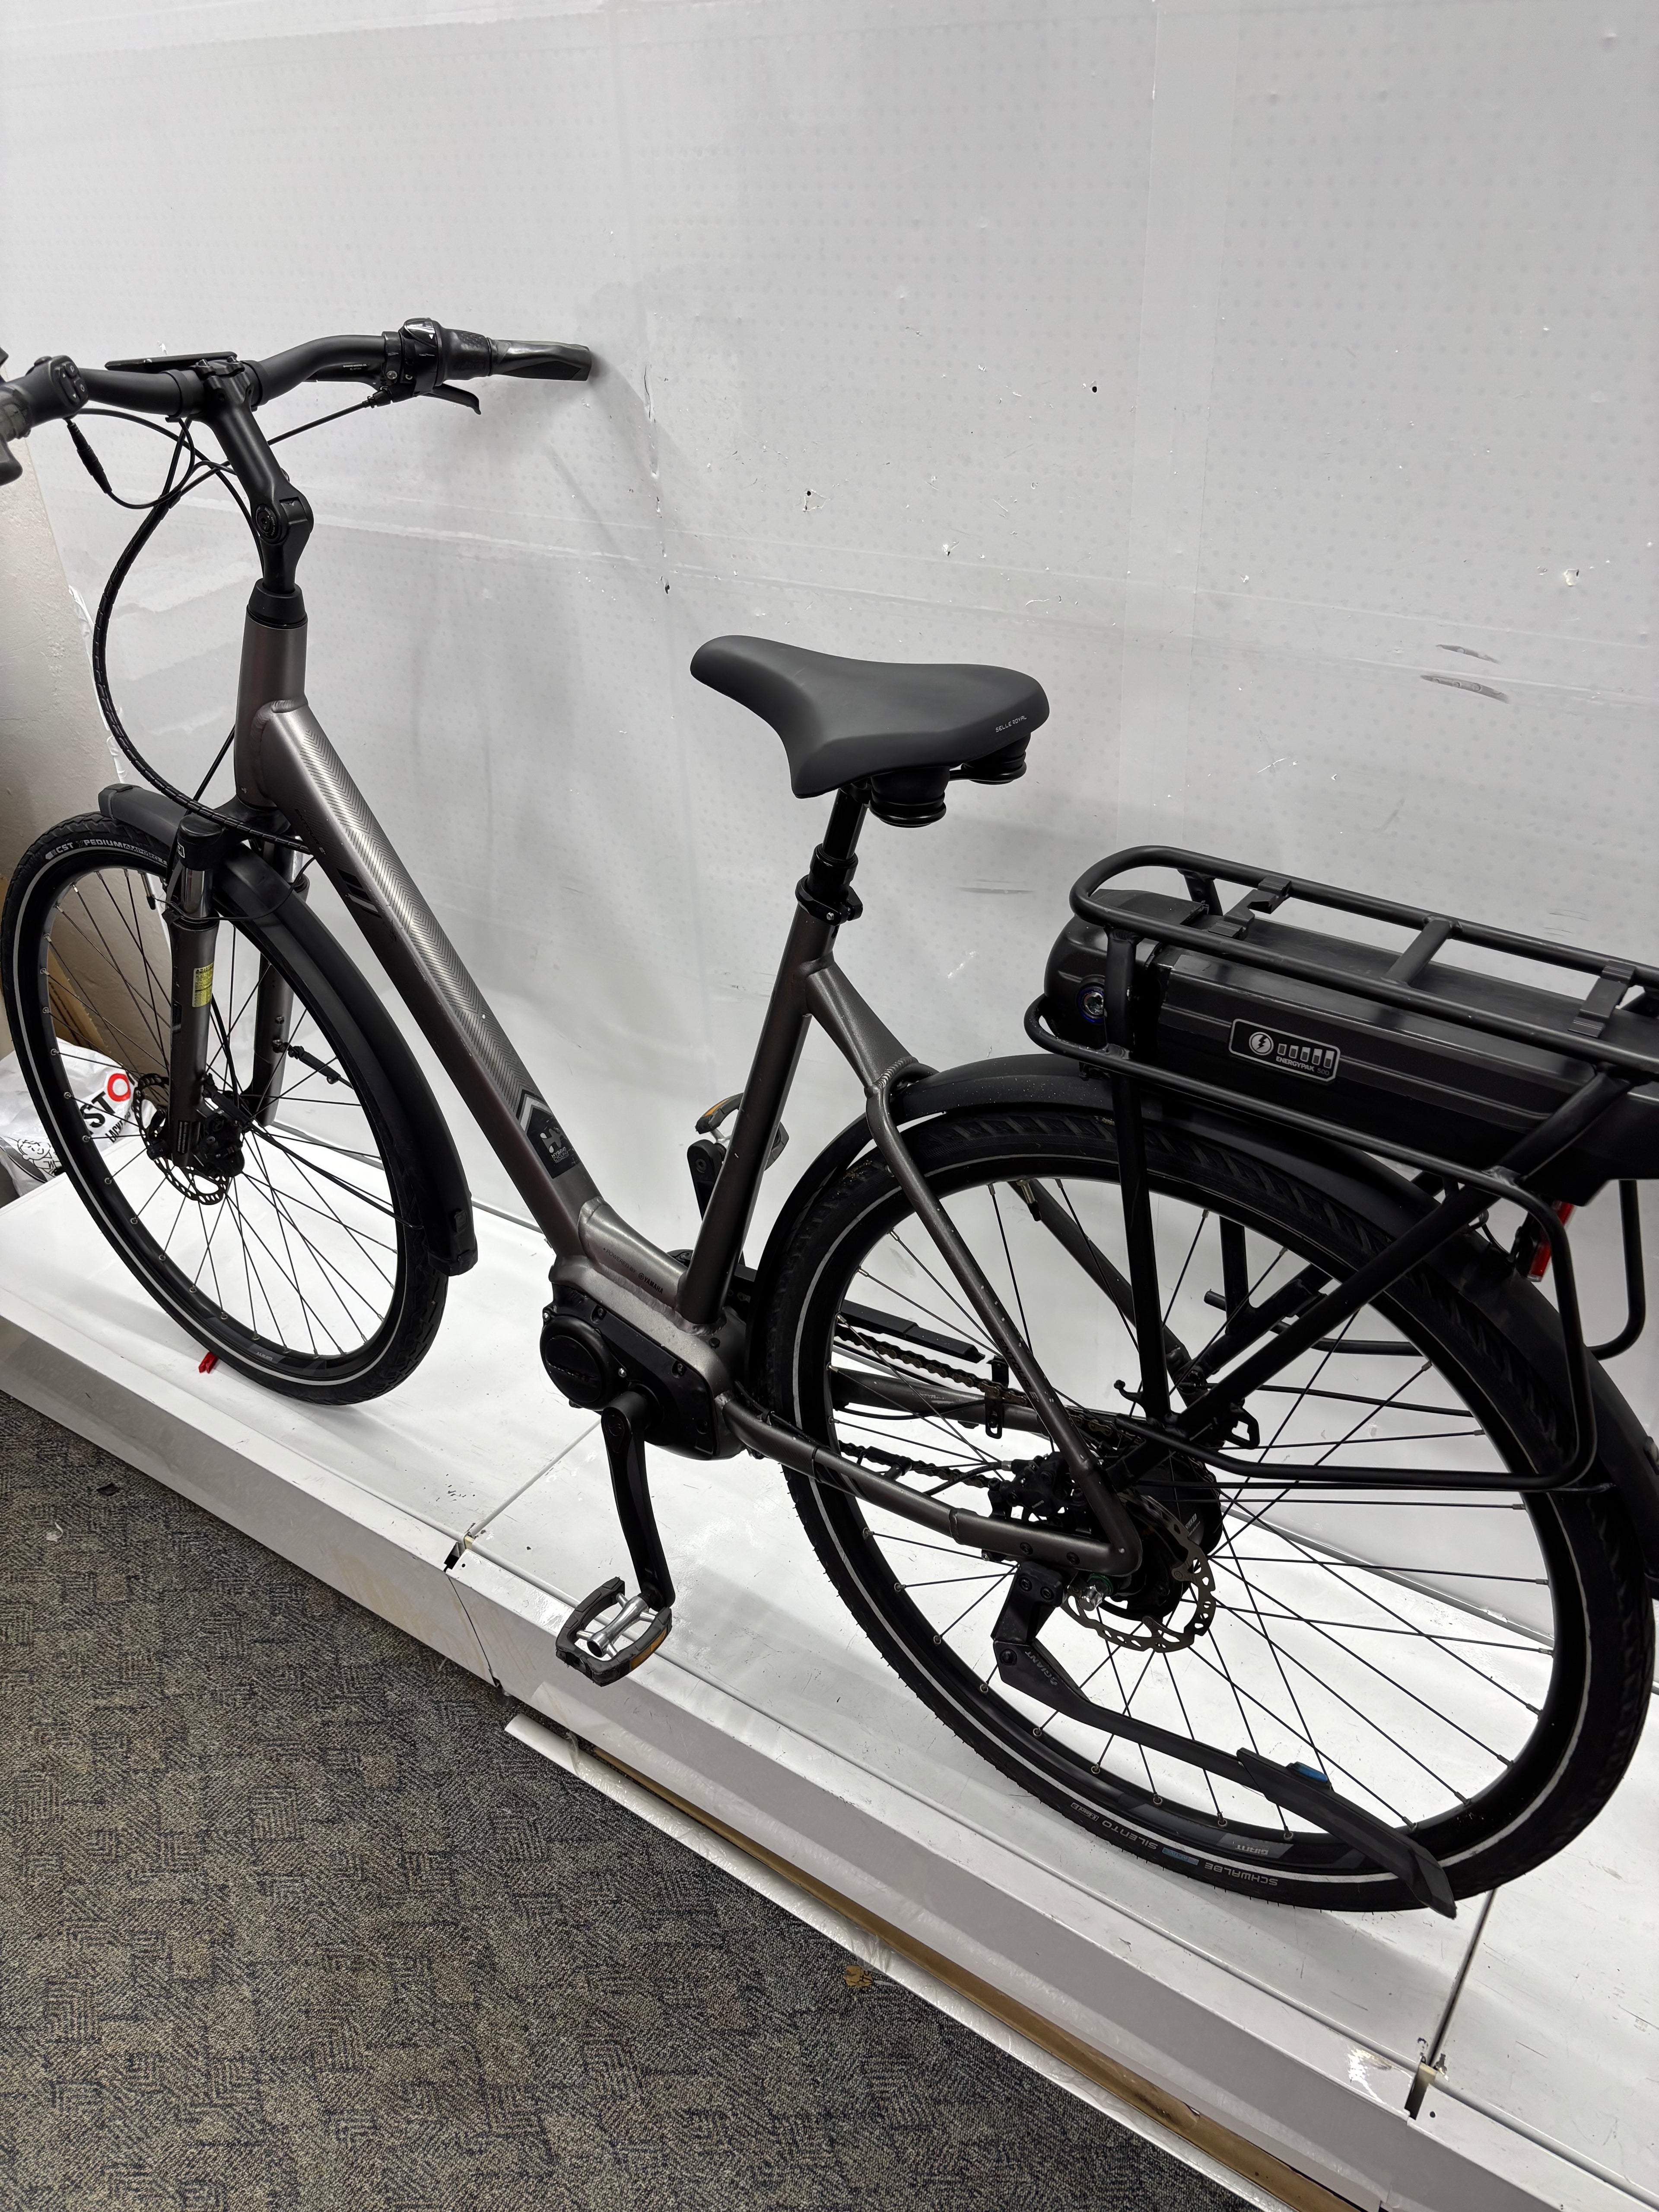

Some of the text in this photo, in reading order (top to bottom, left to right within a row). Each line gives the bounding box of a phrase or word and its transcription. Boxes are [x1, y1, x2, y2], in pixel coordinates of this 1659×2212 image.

[995, 715, 1027, 732] SELLE ROYAL
[55, 842, 74, 855] CST
[1276, 1056, 1330, 1076] ENERGYPAK 500
[551, 1146, 567, 1159] HYBRID
[606, 1249, 629, 1268] POWERED
[645, 1276, 664, 1294] YAMAHA
[998, 1338, 1032, 1387] ENTOUR
[1025, 1651, 1052, 1678] GIANT
[1102, 1820, 1158, 1850] SILENTO
[1234, 1844, 1269, 1856] GIANT
[1204, 1862, 1278, 1886] SCHWALBE
